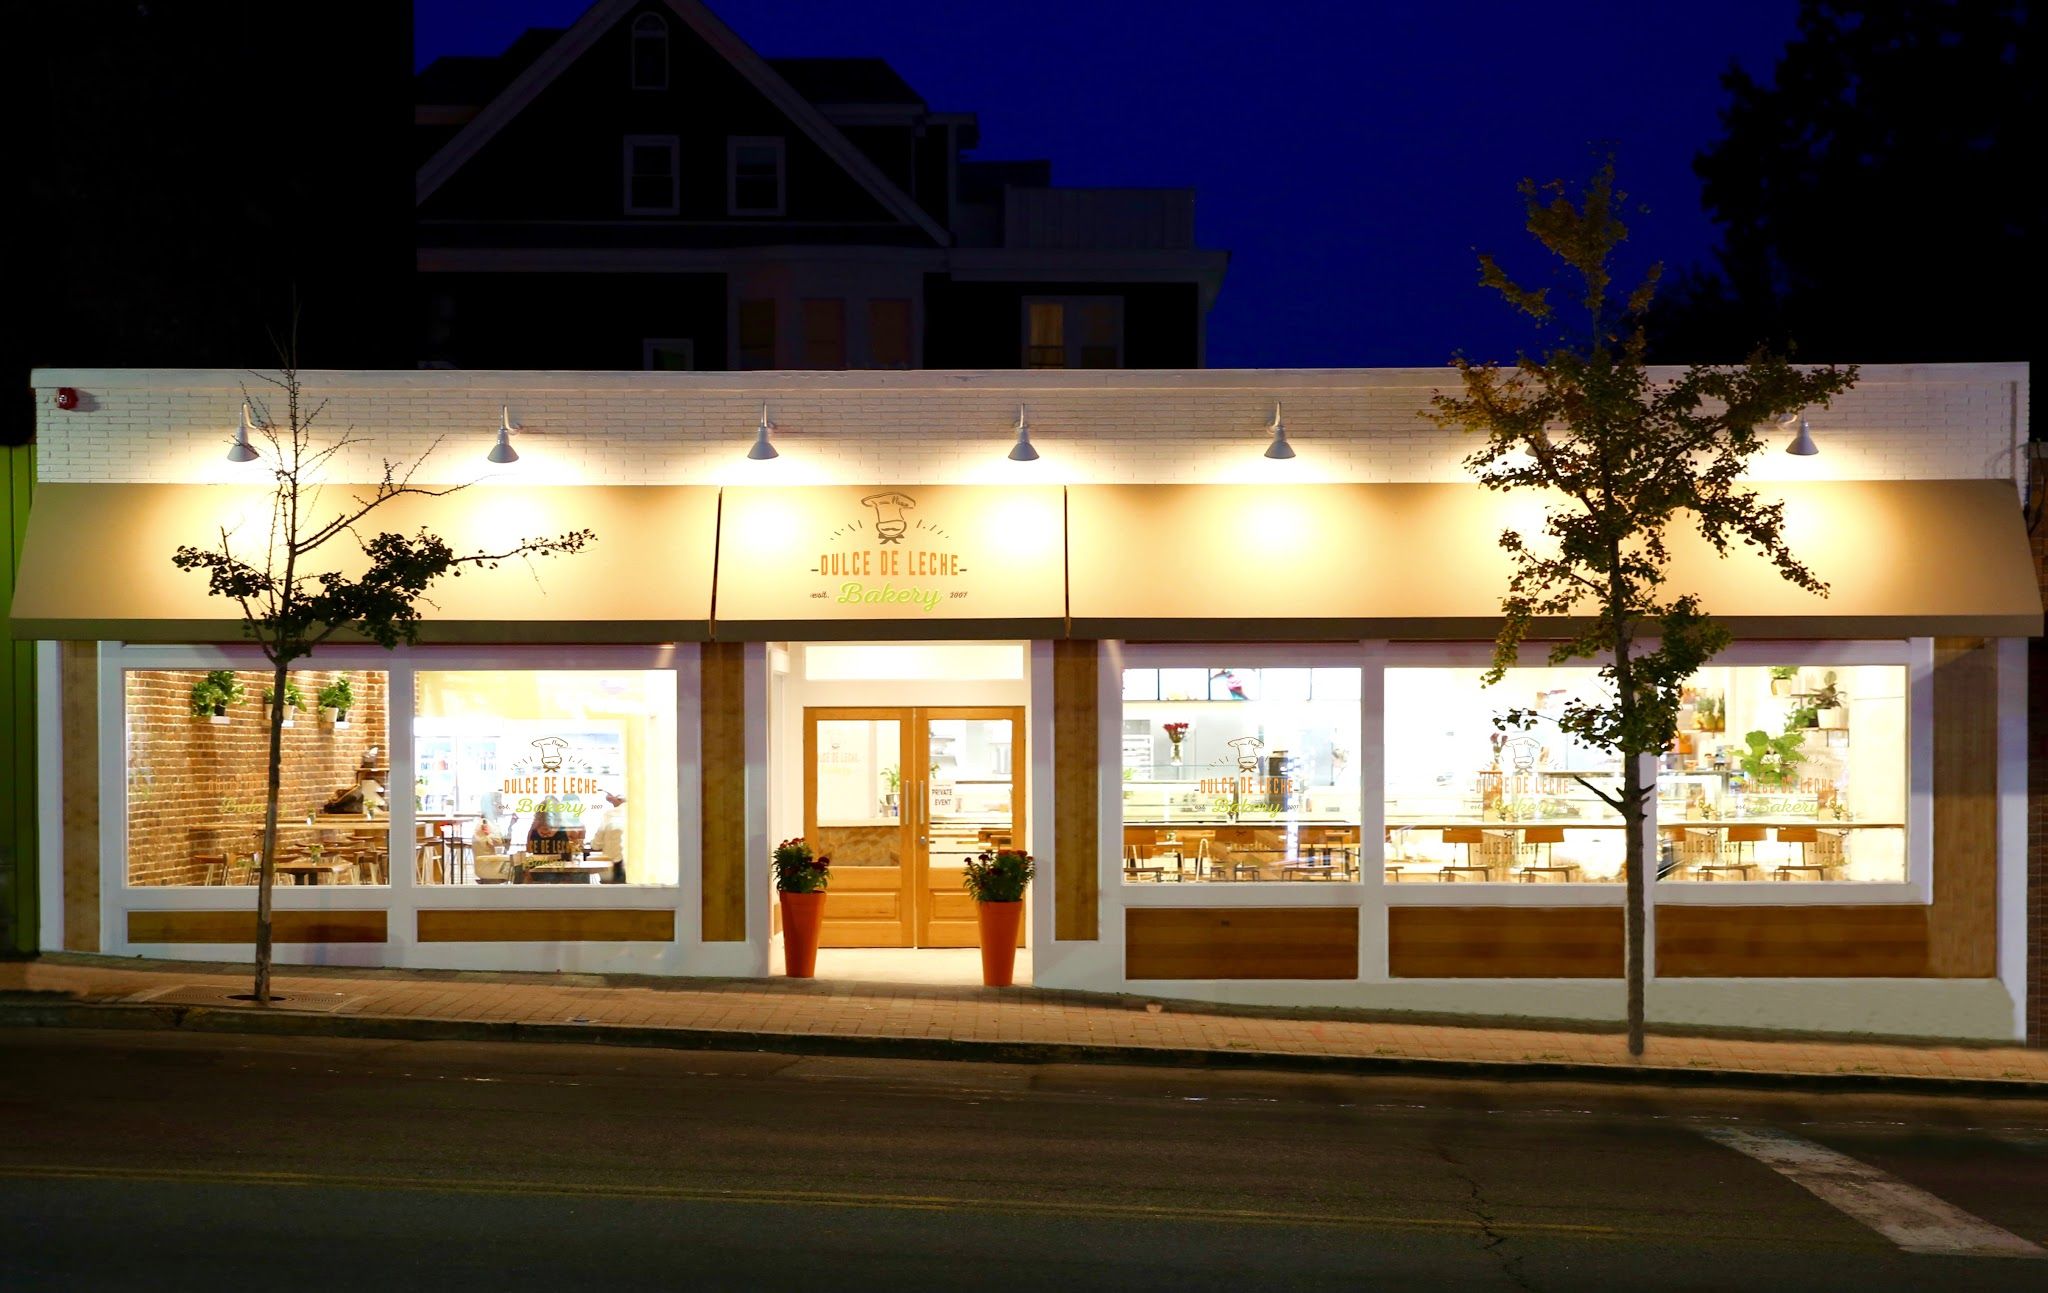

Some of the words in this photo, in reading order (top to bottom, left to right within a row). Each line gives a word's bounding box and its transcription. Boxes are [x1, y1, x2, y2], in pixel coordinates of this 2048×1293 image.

[820, 551, 871, 576] DULCE
[880, 550, 899, 576] DE
[908, 550, 959, 576] LECHE
[836, 582, 942, 613] Bakery
[504, 776, 539, 794] DULCE
[544, 776, 557, 794] DE
[563, 776, 597, 794] LECHE
[931, 788, 953, 796] PRIVATE
[1200, 776, 1234, 794] DULCE
[1240, 776, 1253, 794] DE
[1259, 776, 1294, 795] LECHE
[1516, 776, 1529, 794] DE
[1535, 776, 1569, 794] LECHE
[515, 798, 587, 817] Bakery
[934, 798, 951, 806] EVENT
[1212, 798, 1282, 819] Bakery
